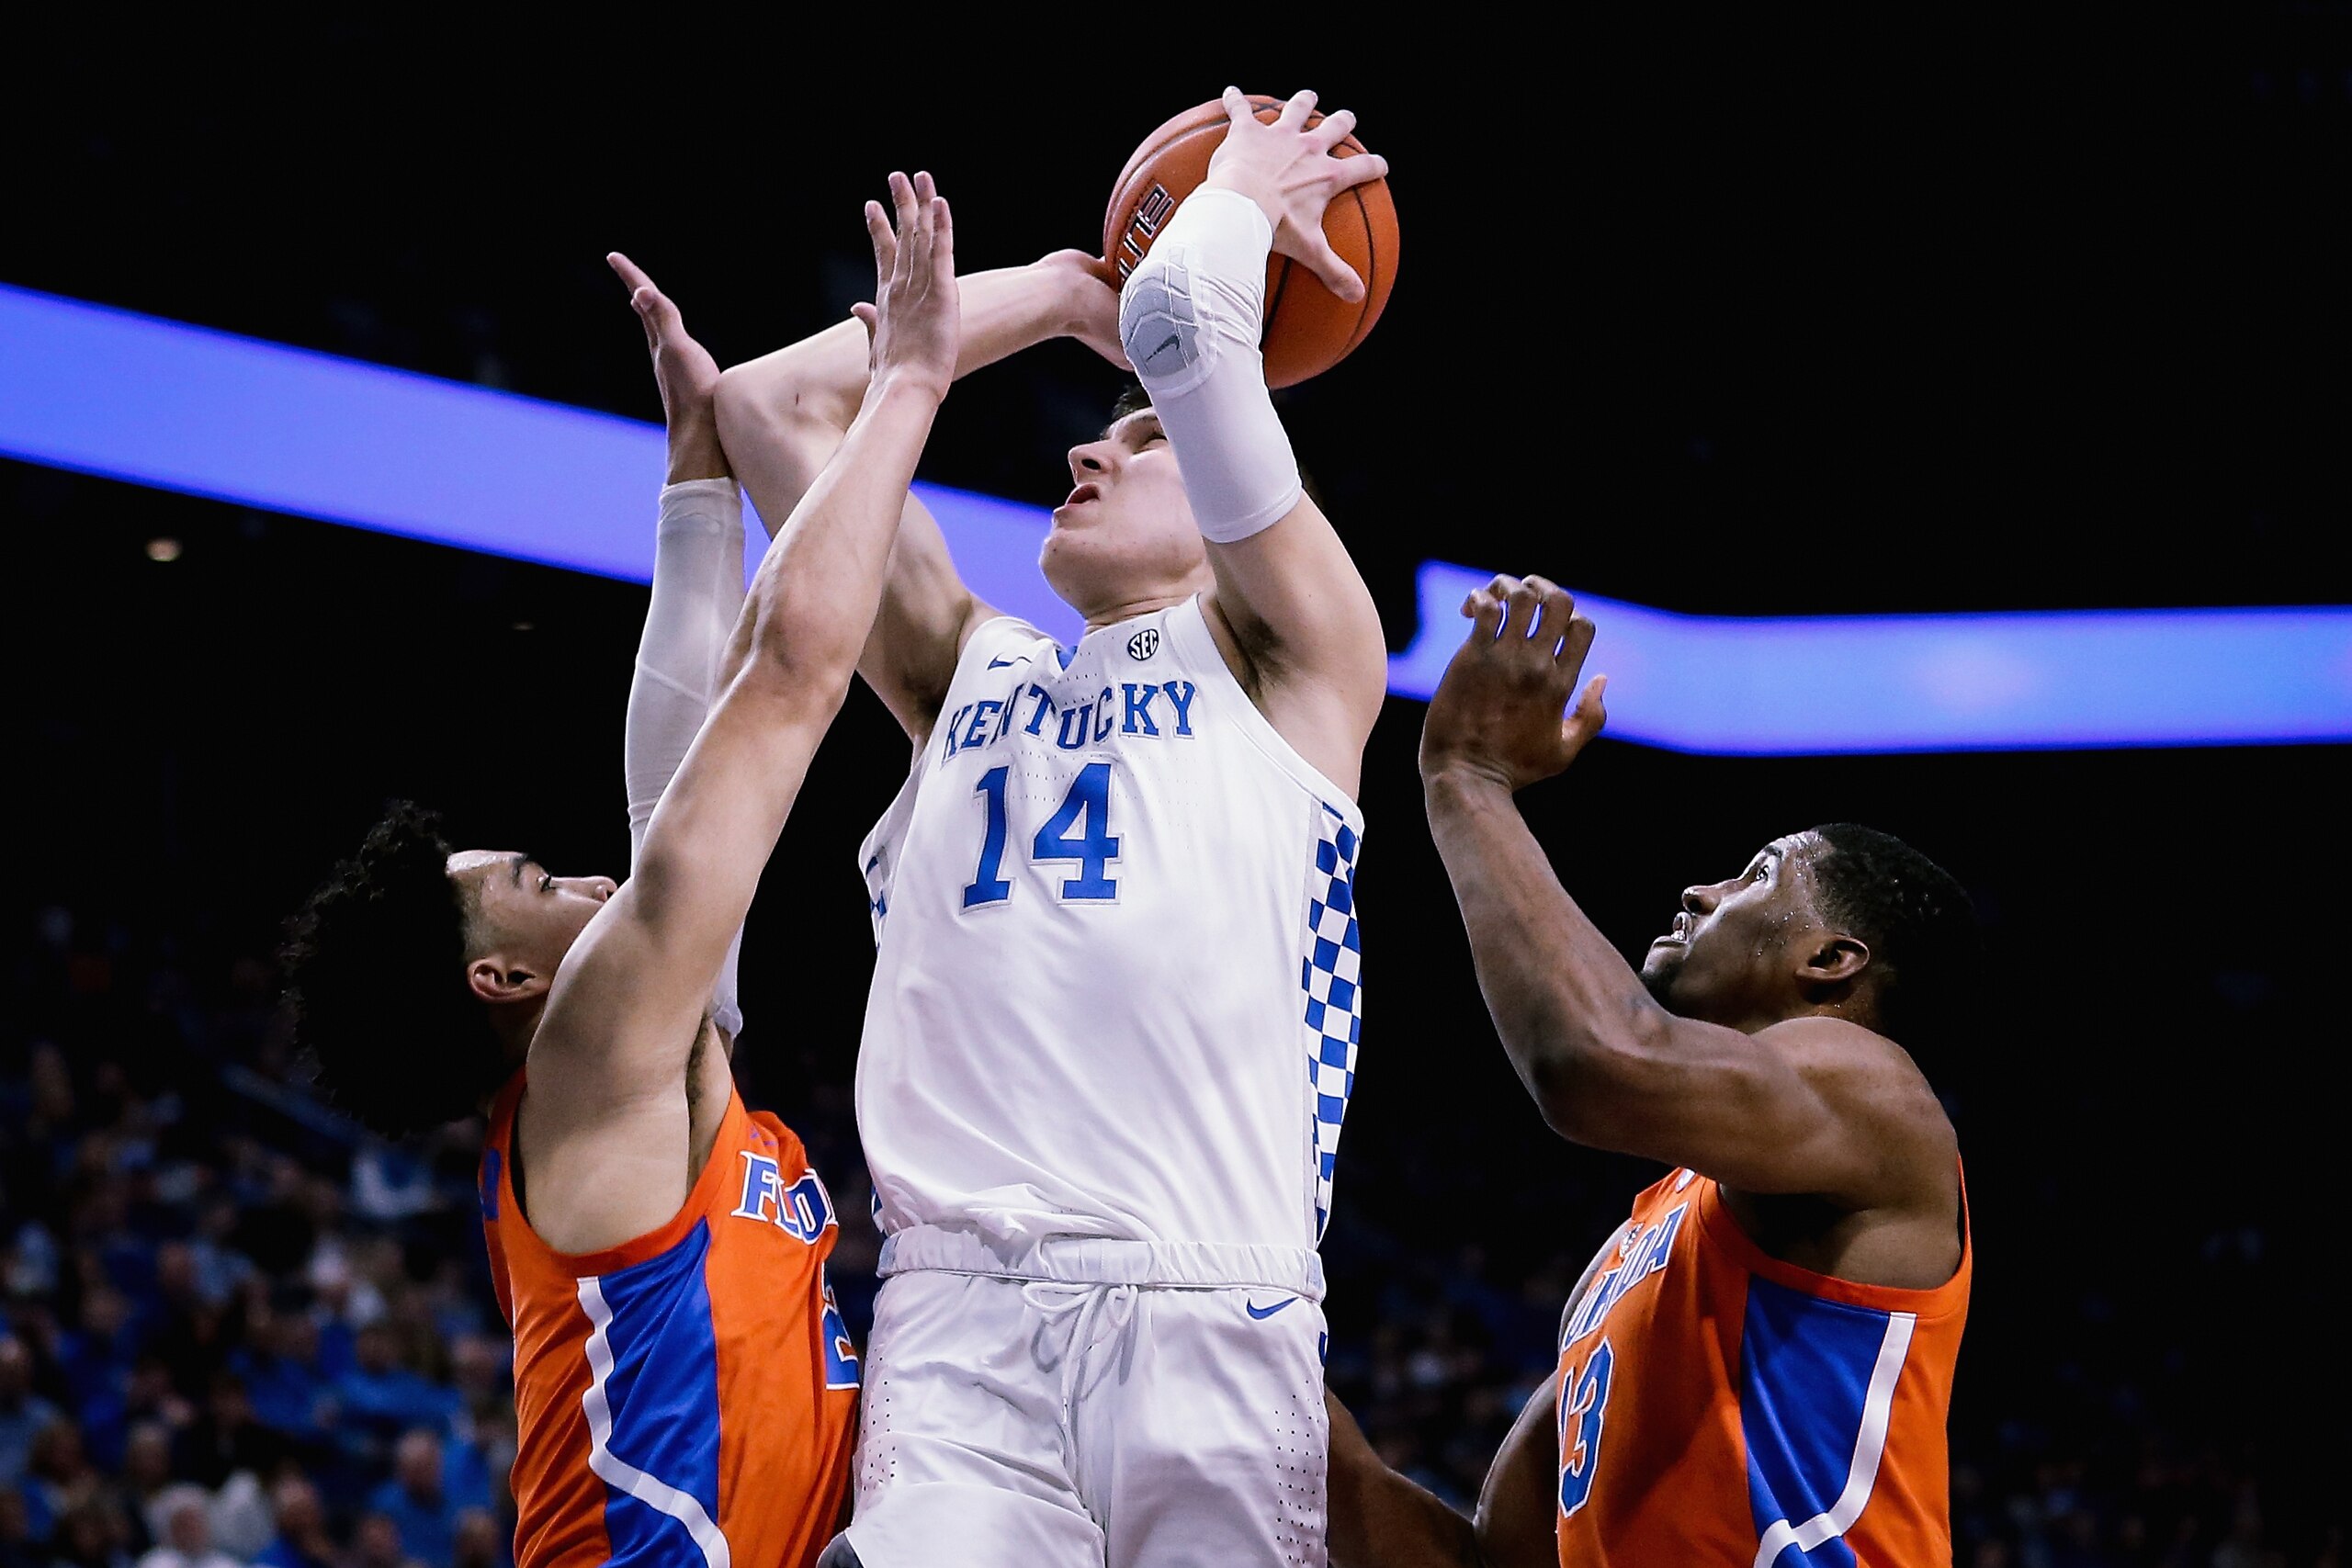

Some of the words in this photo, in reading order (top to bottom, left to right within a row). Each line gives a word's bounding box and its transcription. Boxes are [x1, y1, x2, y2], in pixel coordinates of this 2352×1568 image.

[1118, 183, 1175, 280] LITE
[1128, 629, 1159, 660] SEC
[942, 680, 1196, 768] KENTUCKY
[960, 761, 1123, 914] 14
